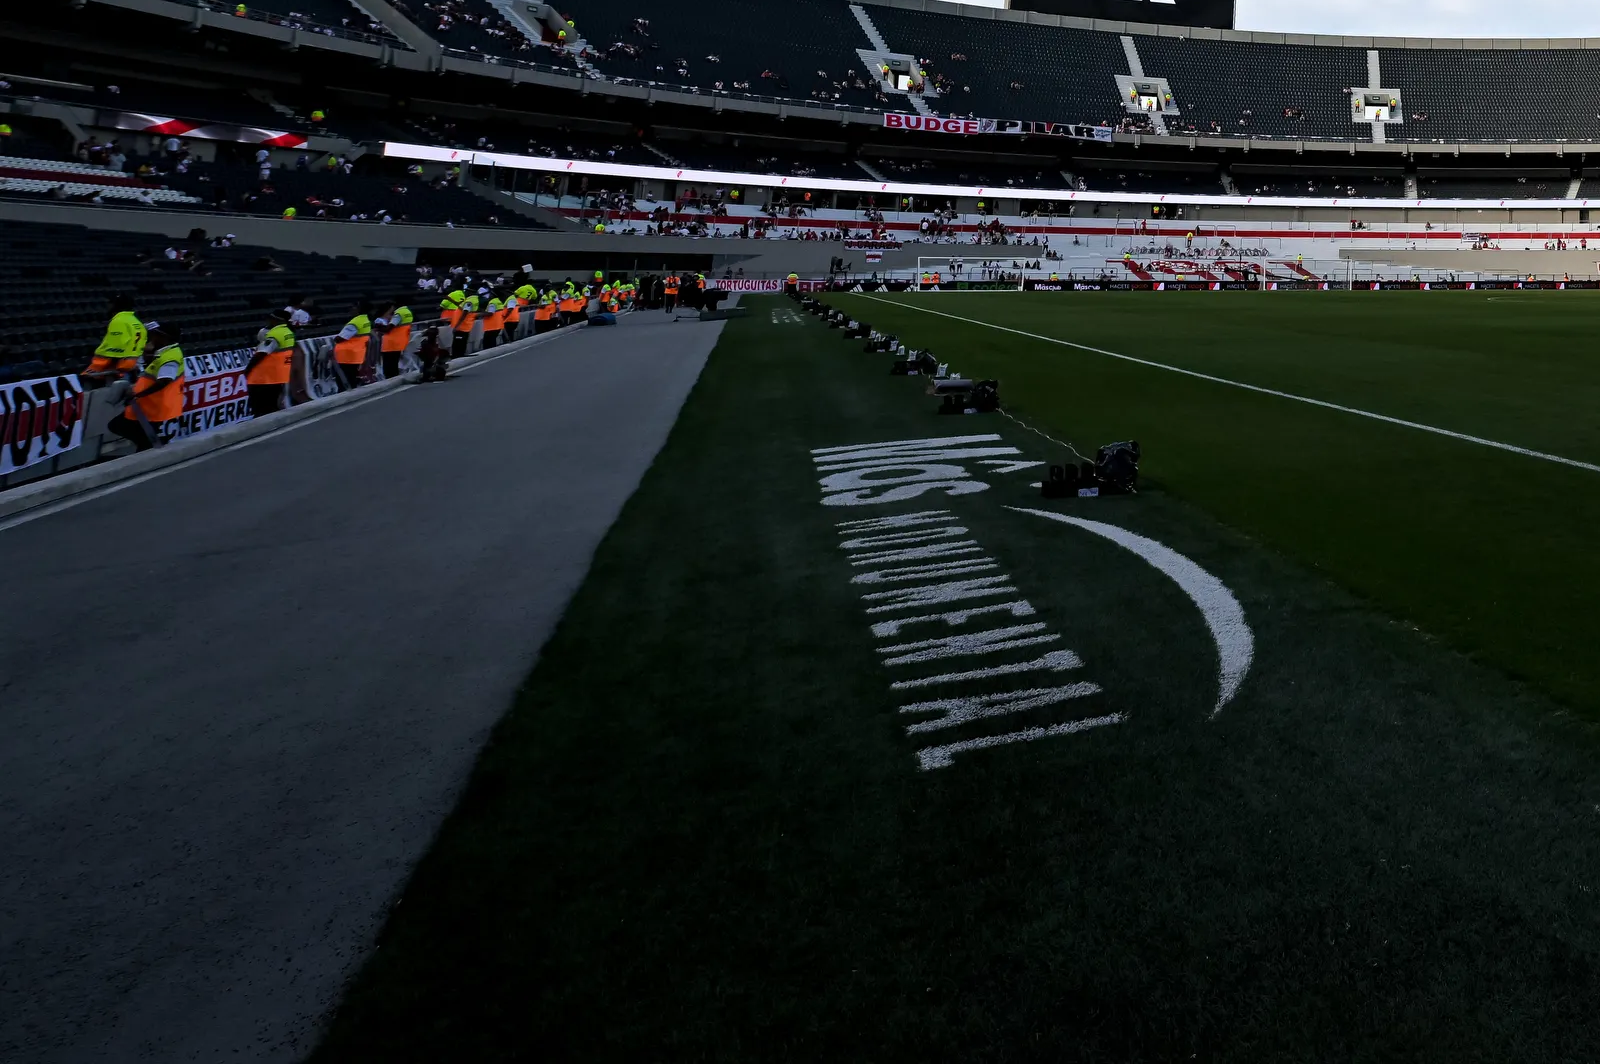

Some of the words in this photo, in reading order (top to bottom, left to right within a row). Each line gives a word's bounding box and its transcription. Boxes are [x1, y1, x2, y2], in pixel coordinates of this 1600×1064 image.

[886, 114, 979, 134] BUDGE
[715, 279, 778, 290] TORTUGUITAS
[195, 355, 214, 375] DE
[835, 509, 1131, 771] MONUMENTAL
